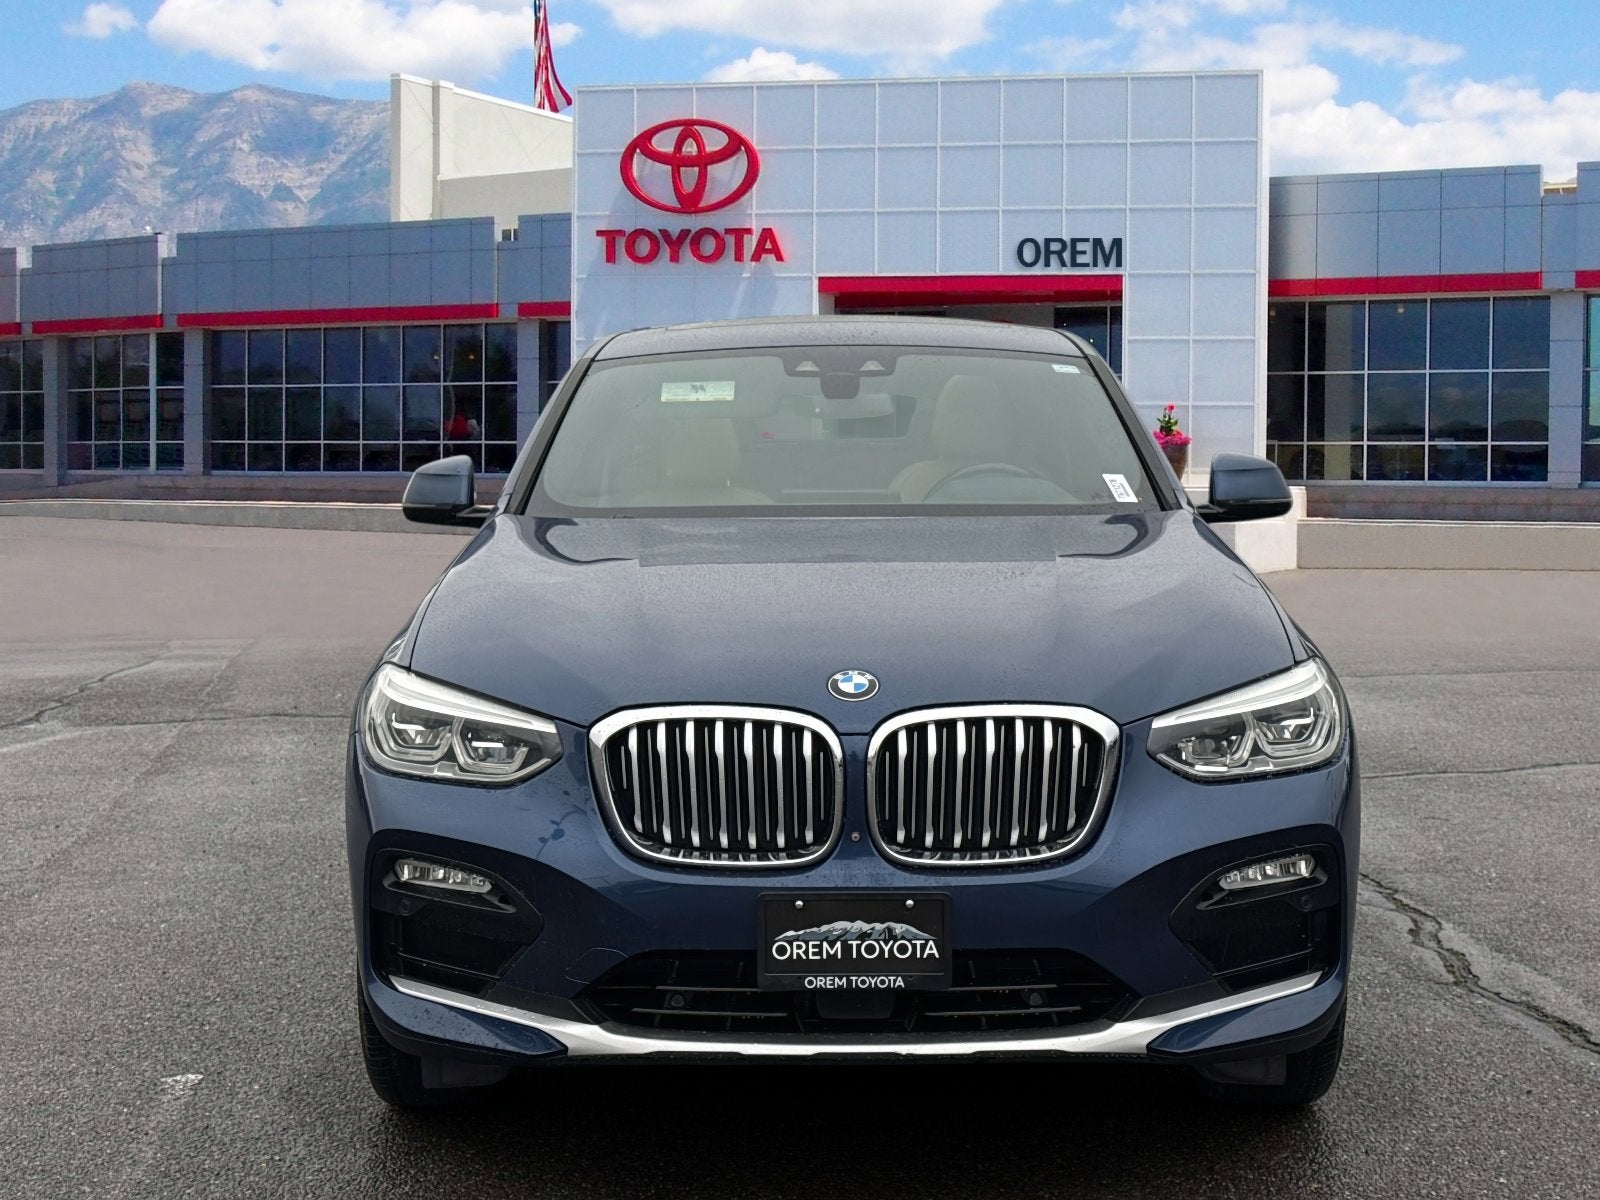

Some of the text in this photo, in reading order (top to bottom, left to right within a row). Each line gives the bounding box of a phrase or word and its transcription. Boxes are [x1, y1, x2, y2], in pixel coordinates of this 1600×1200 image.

[596, 227, 785, 265] TOYOTA
[1016, 237, 1123, 268] OREM
[771, 939, 940, 960] OREM TOYOTA
[804, 976, 905, 989] OREM TOYOTA
